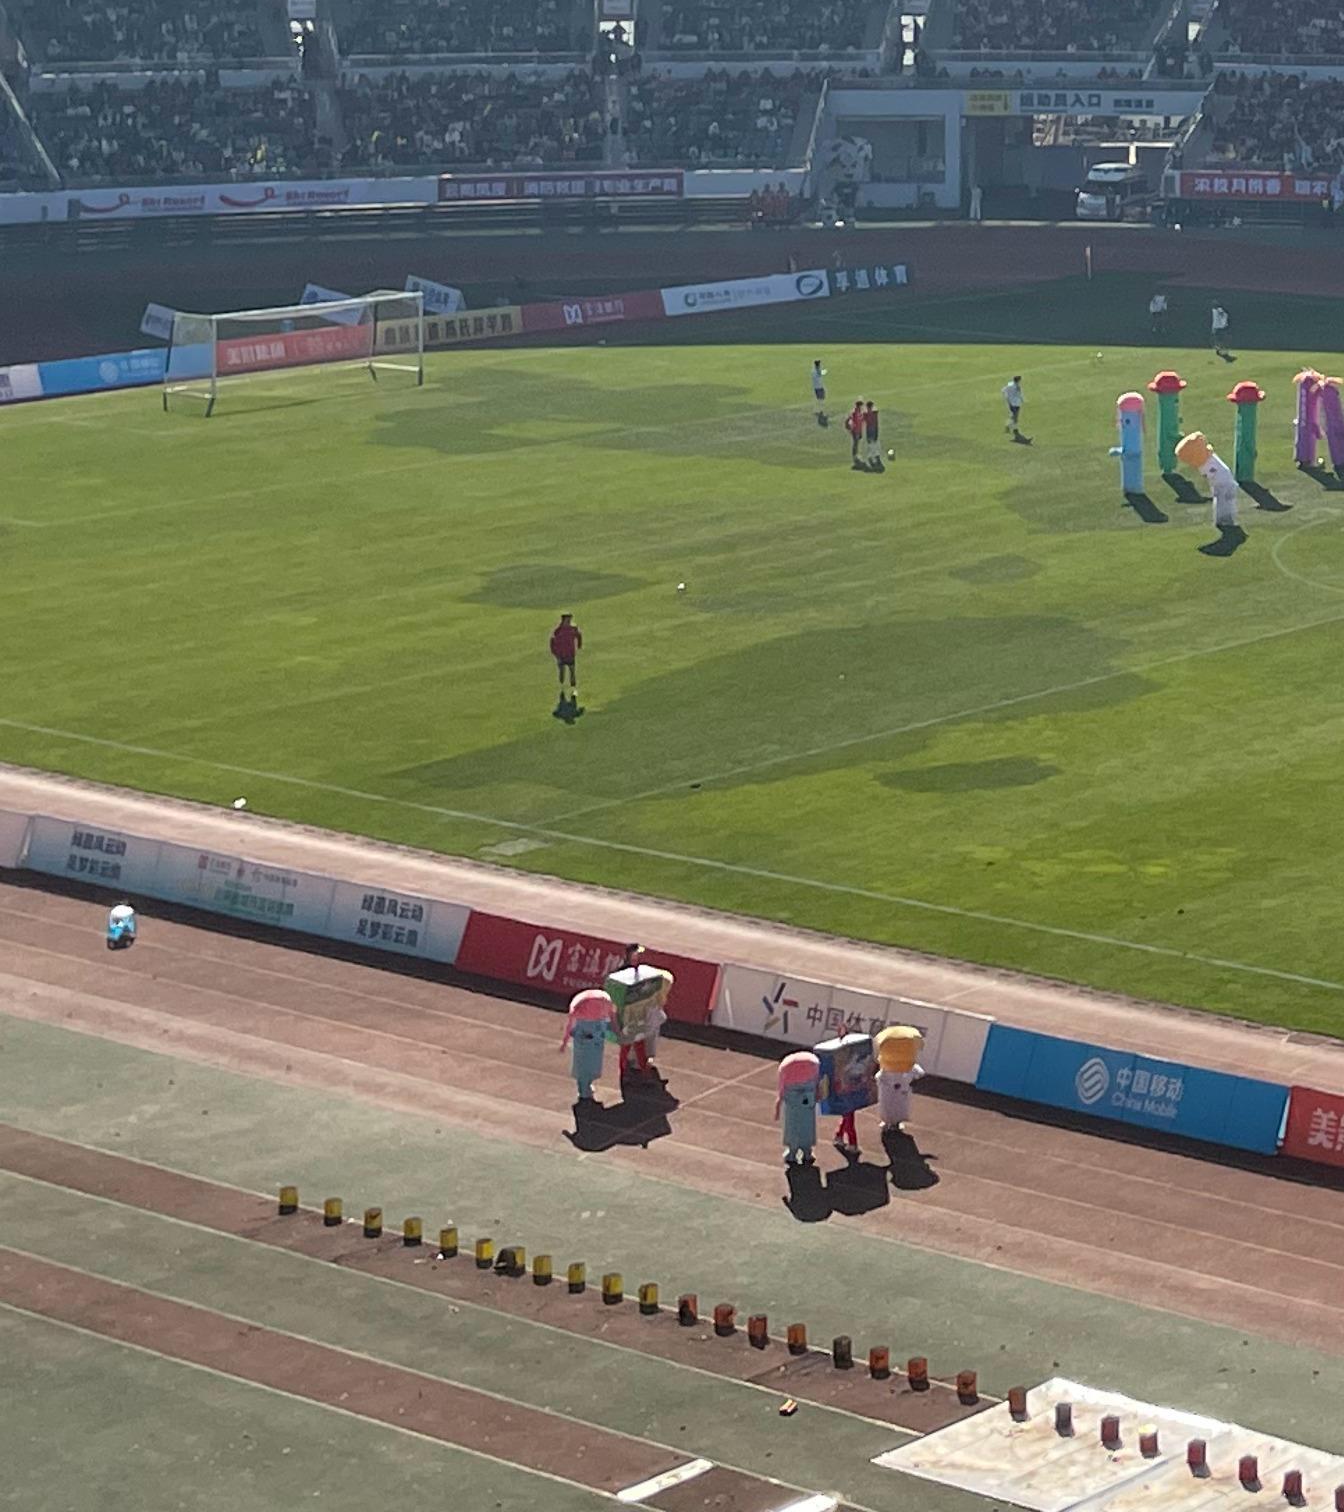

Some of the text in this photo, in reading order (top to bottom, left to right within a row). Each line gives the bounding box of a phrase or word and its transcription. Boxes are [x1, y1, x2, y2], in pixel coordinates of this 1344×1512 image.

[1116, 1067, 1184, 1102] 中国移动
[1111, 1091, 1143, 1111] China
